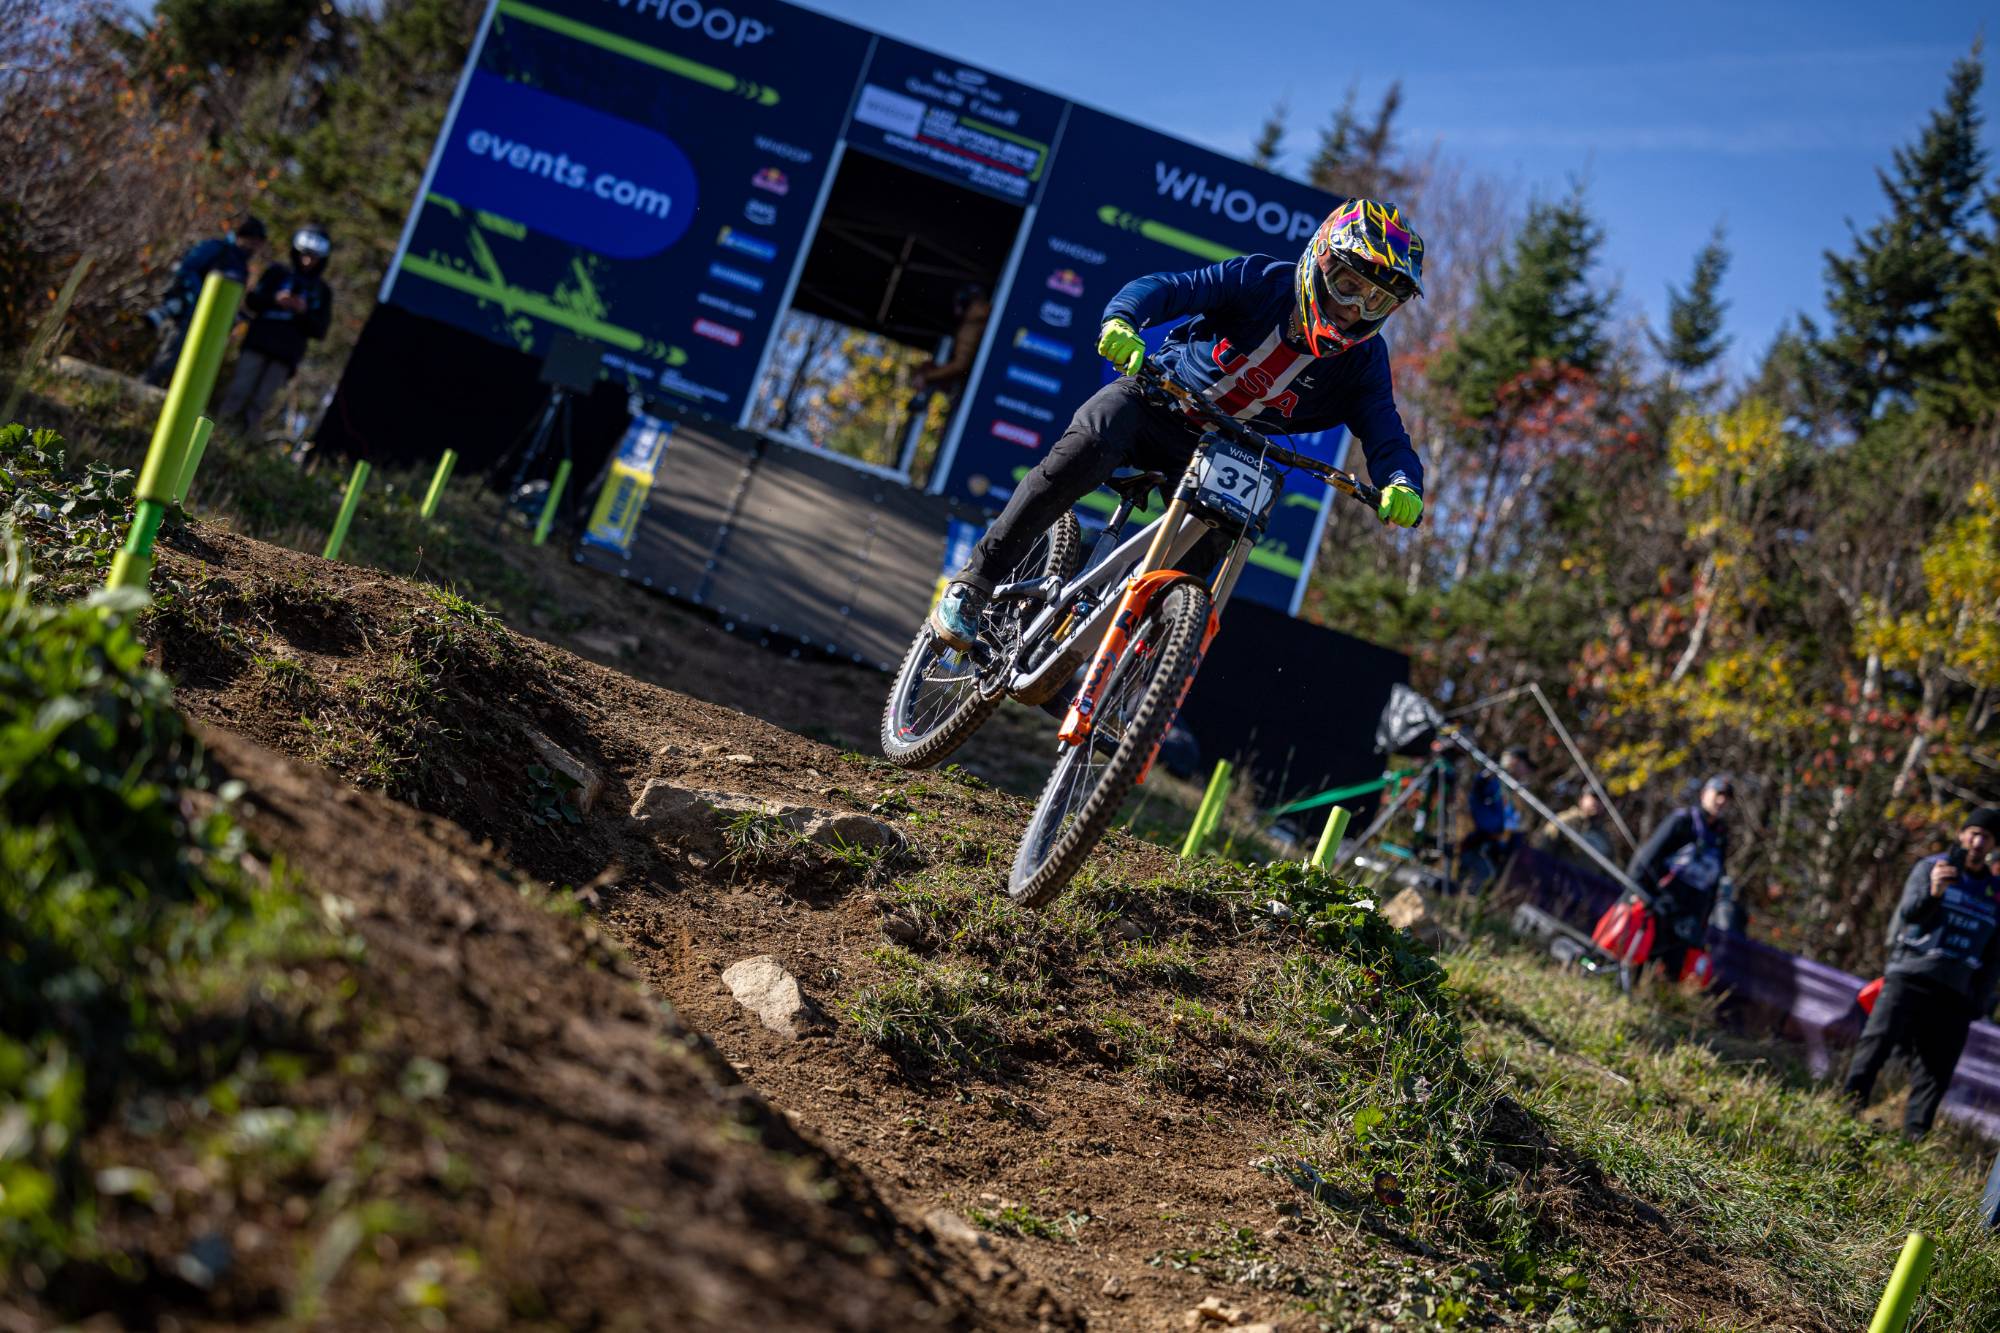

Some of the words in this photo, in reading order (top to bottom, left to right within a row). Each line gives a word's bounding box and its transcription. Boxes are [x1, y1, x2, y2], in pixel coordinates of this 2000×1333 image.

[611, 0, 766, 47] HOOP
[467, 129, 673, 220] events.com
[1156, 161, 1318, 241] WHOOP
[1212, 337, 1299, 418] USA
[1217, 466, 1259, 499] 37
